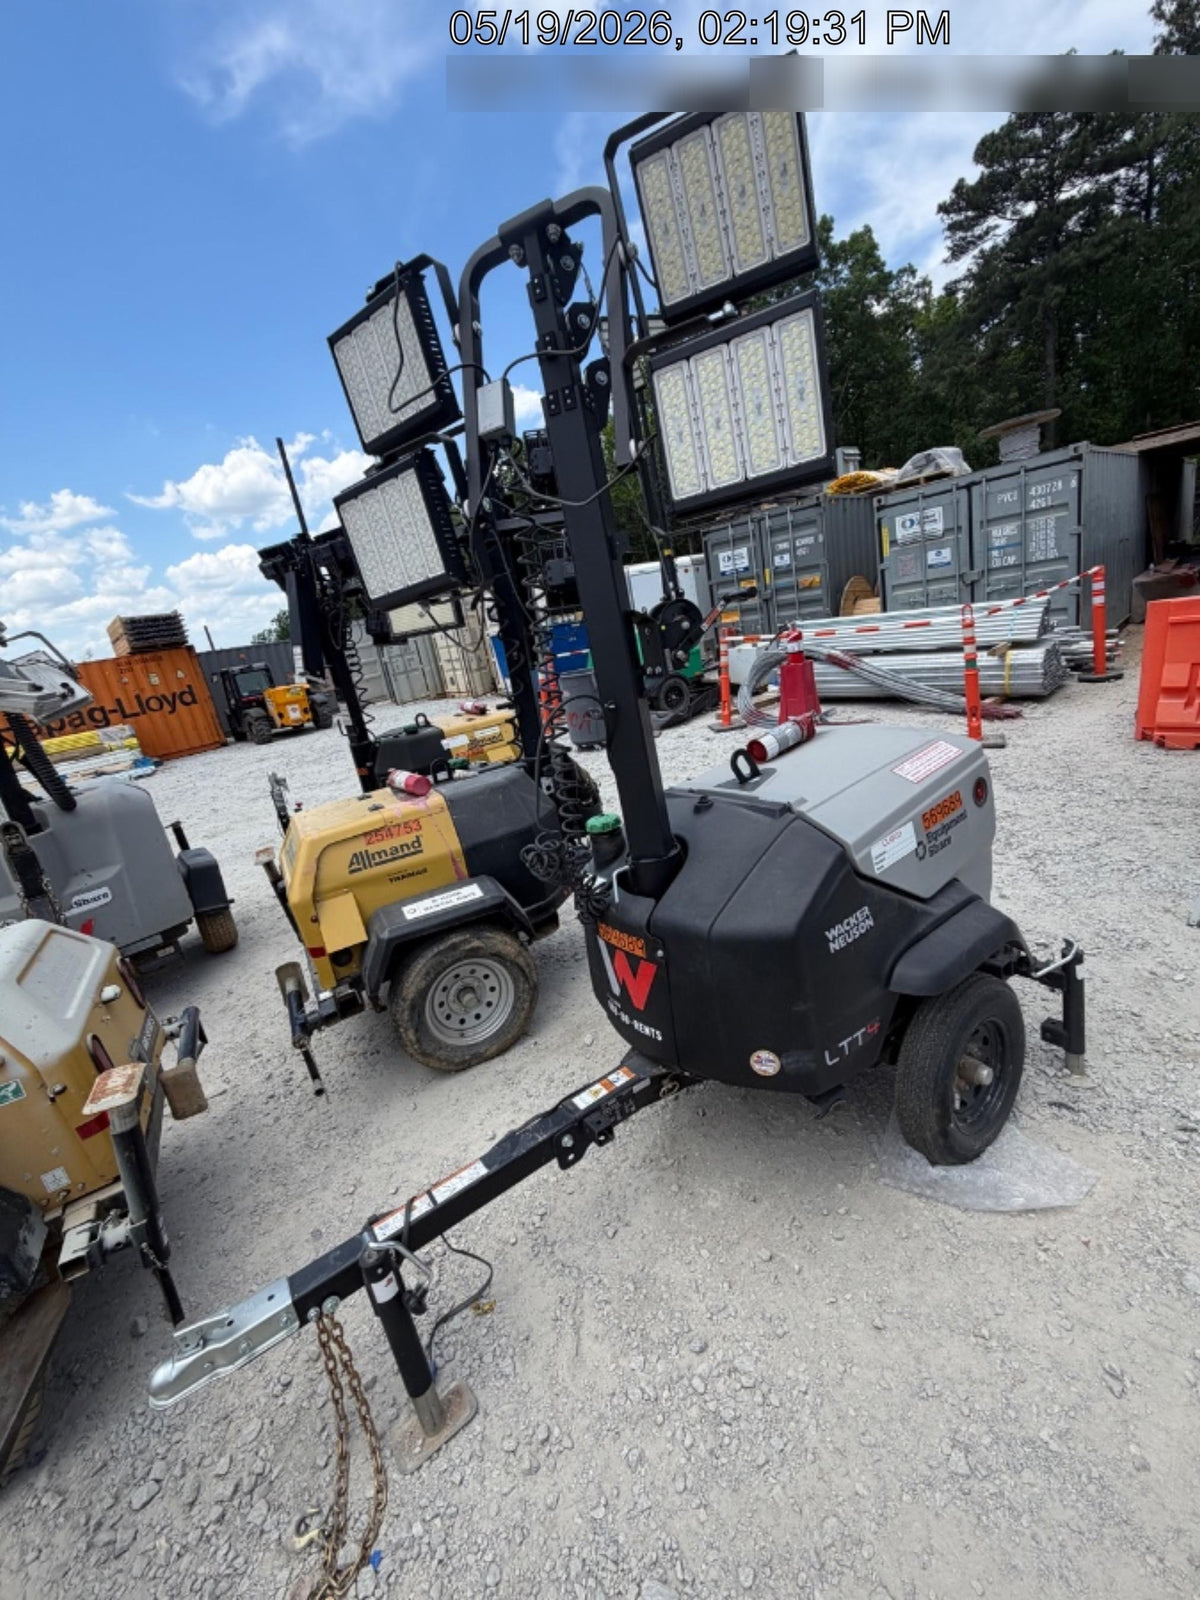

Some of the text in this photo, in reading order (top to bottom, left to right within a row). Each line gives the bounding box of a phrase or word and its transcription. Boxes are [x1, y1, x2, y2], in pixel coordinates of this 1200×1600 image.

[348, 835, 423, 871] Allmand
[824, 905, 870, 941] WACKER
[828, 916, 874, 954] NEUSON
